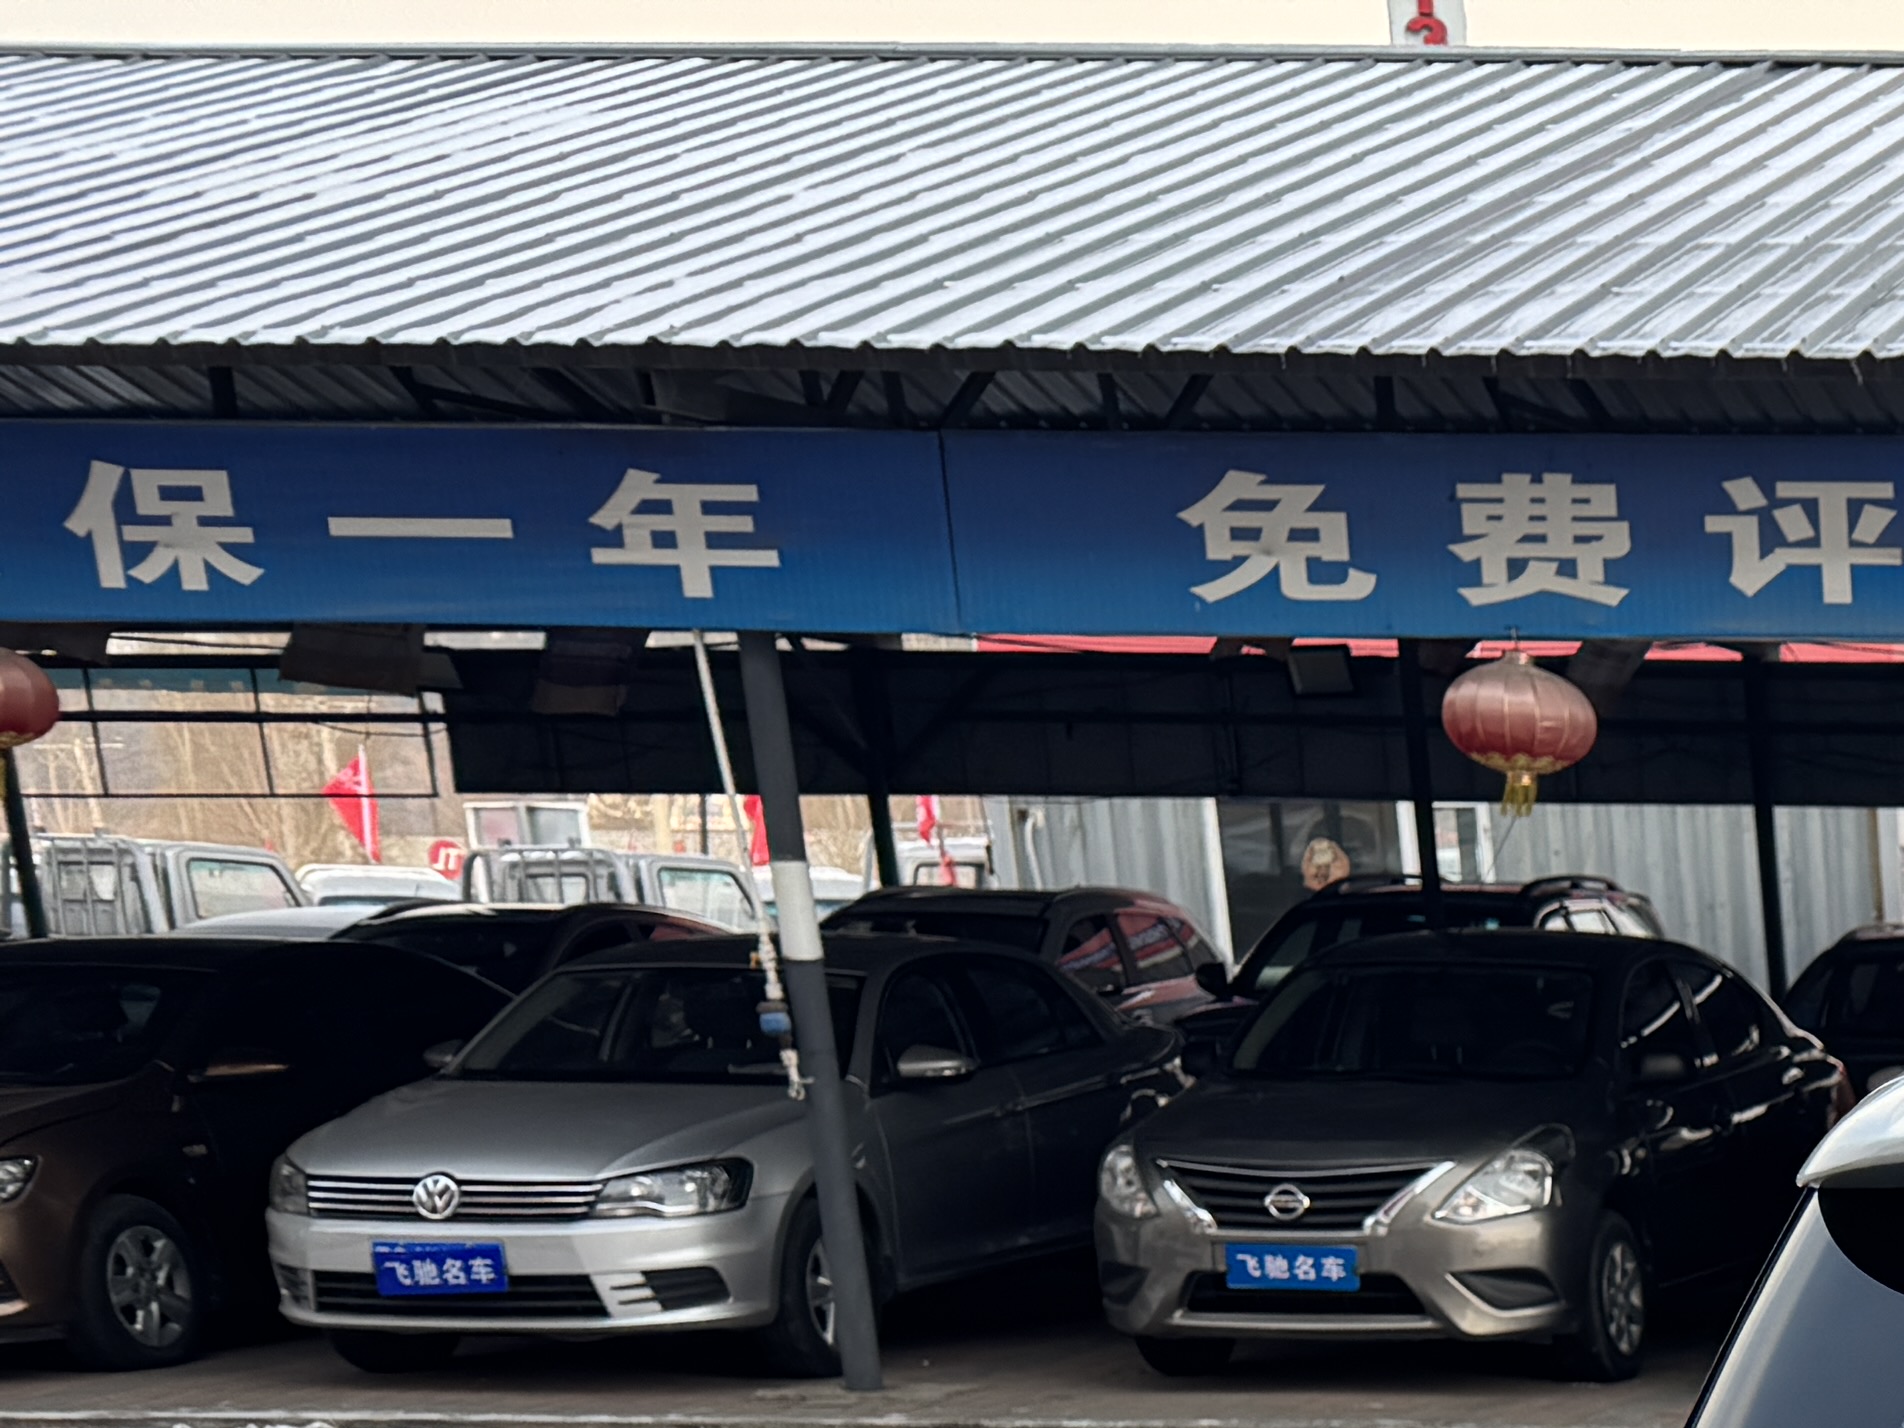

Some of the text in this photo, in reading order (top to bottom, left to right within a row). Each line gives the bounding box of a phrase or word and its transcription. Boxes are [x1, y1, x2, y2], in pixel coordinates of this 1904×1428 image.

[62, 459, 782, 599] 保一年
[382, 1256, 498, 1287] 飞驰名车
[1235, 1253, 1347, 1282] 飞驰名车
